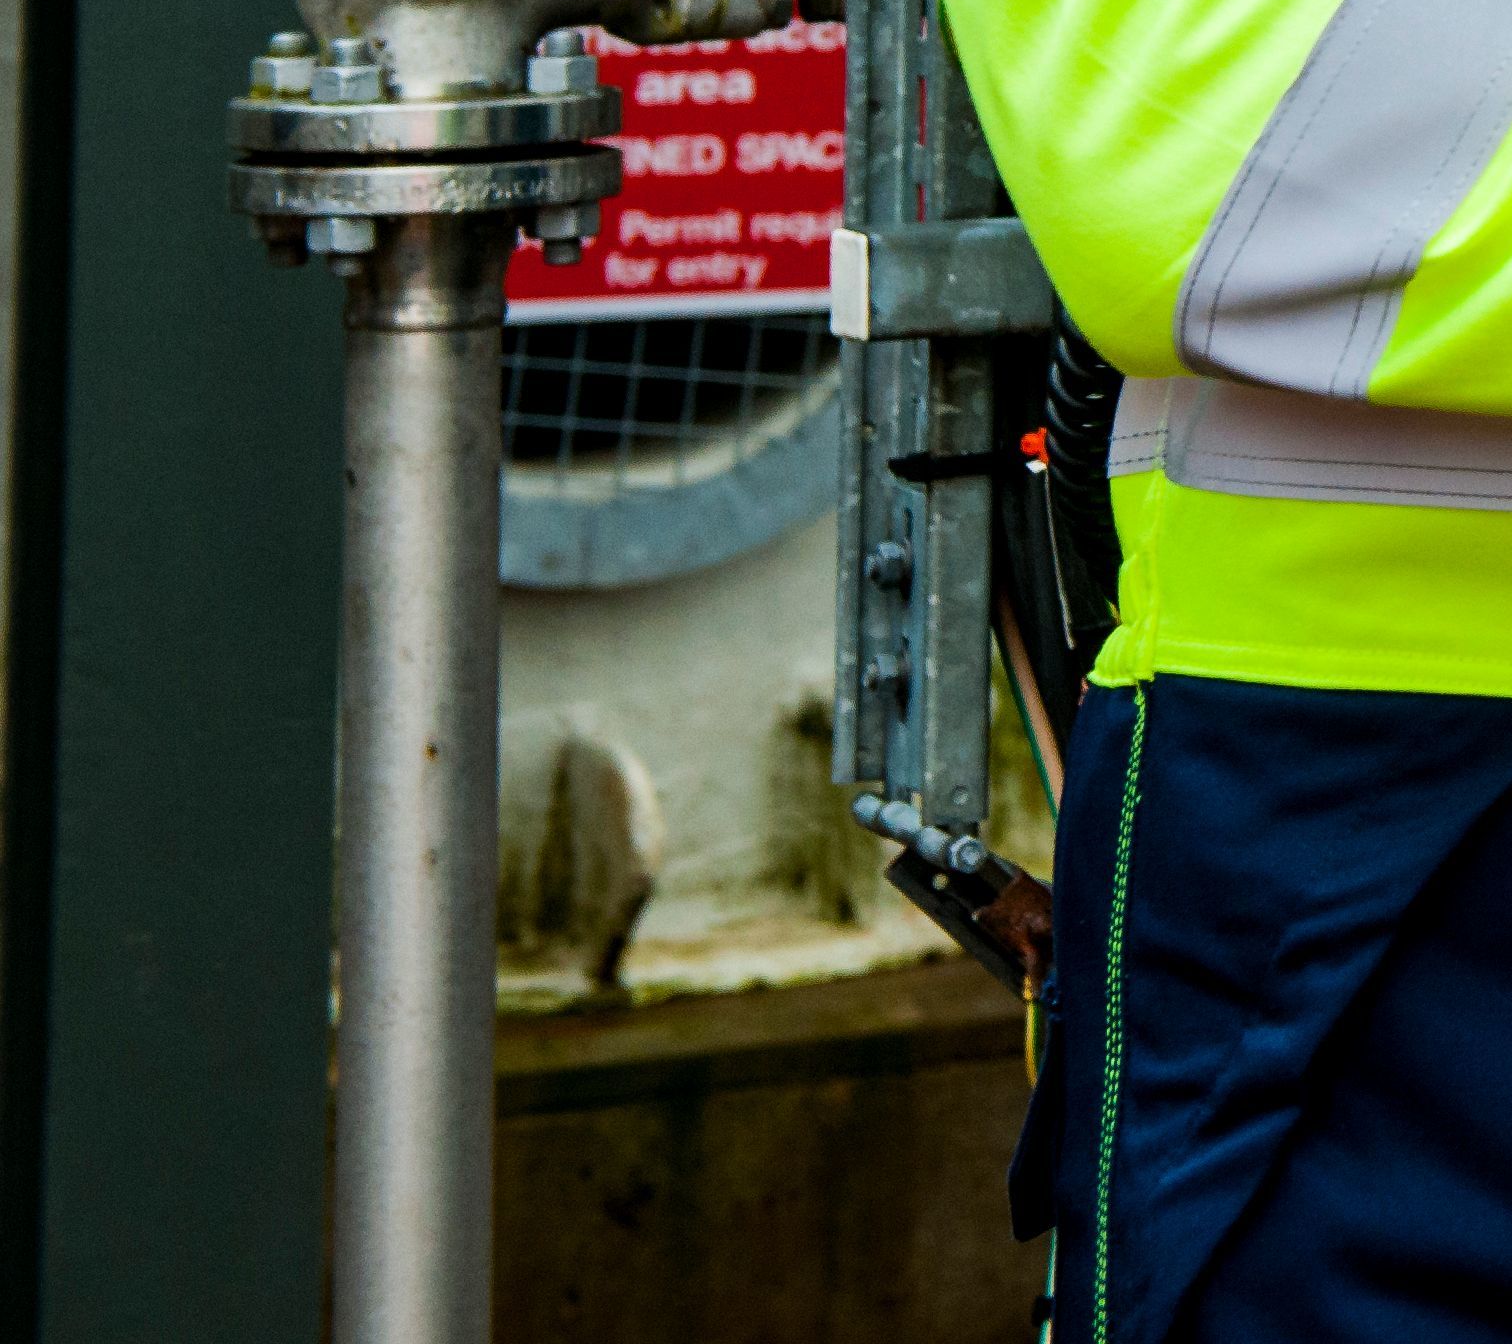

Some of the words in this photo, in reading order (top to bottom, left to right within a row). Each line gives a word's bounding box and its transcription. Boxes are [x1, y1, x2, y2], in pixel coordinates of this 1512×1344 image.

[634, 68, 757, 105] area
[736, 131, 845, 174] SPAC
[618, 209, 743, 247] Permit
[603, 251, 658, 288] for
[665, 251, 769, 291] entry
